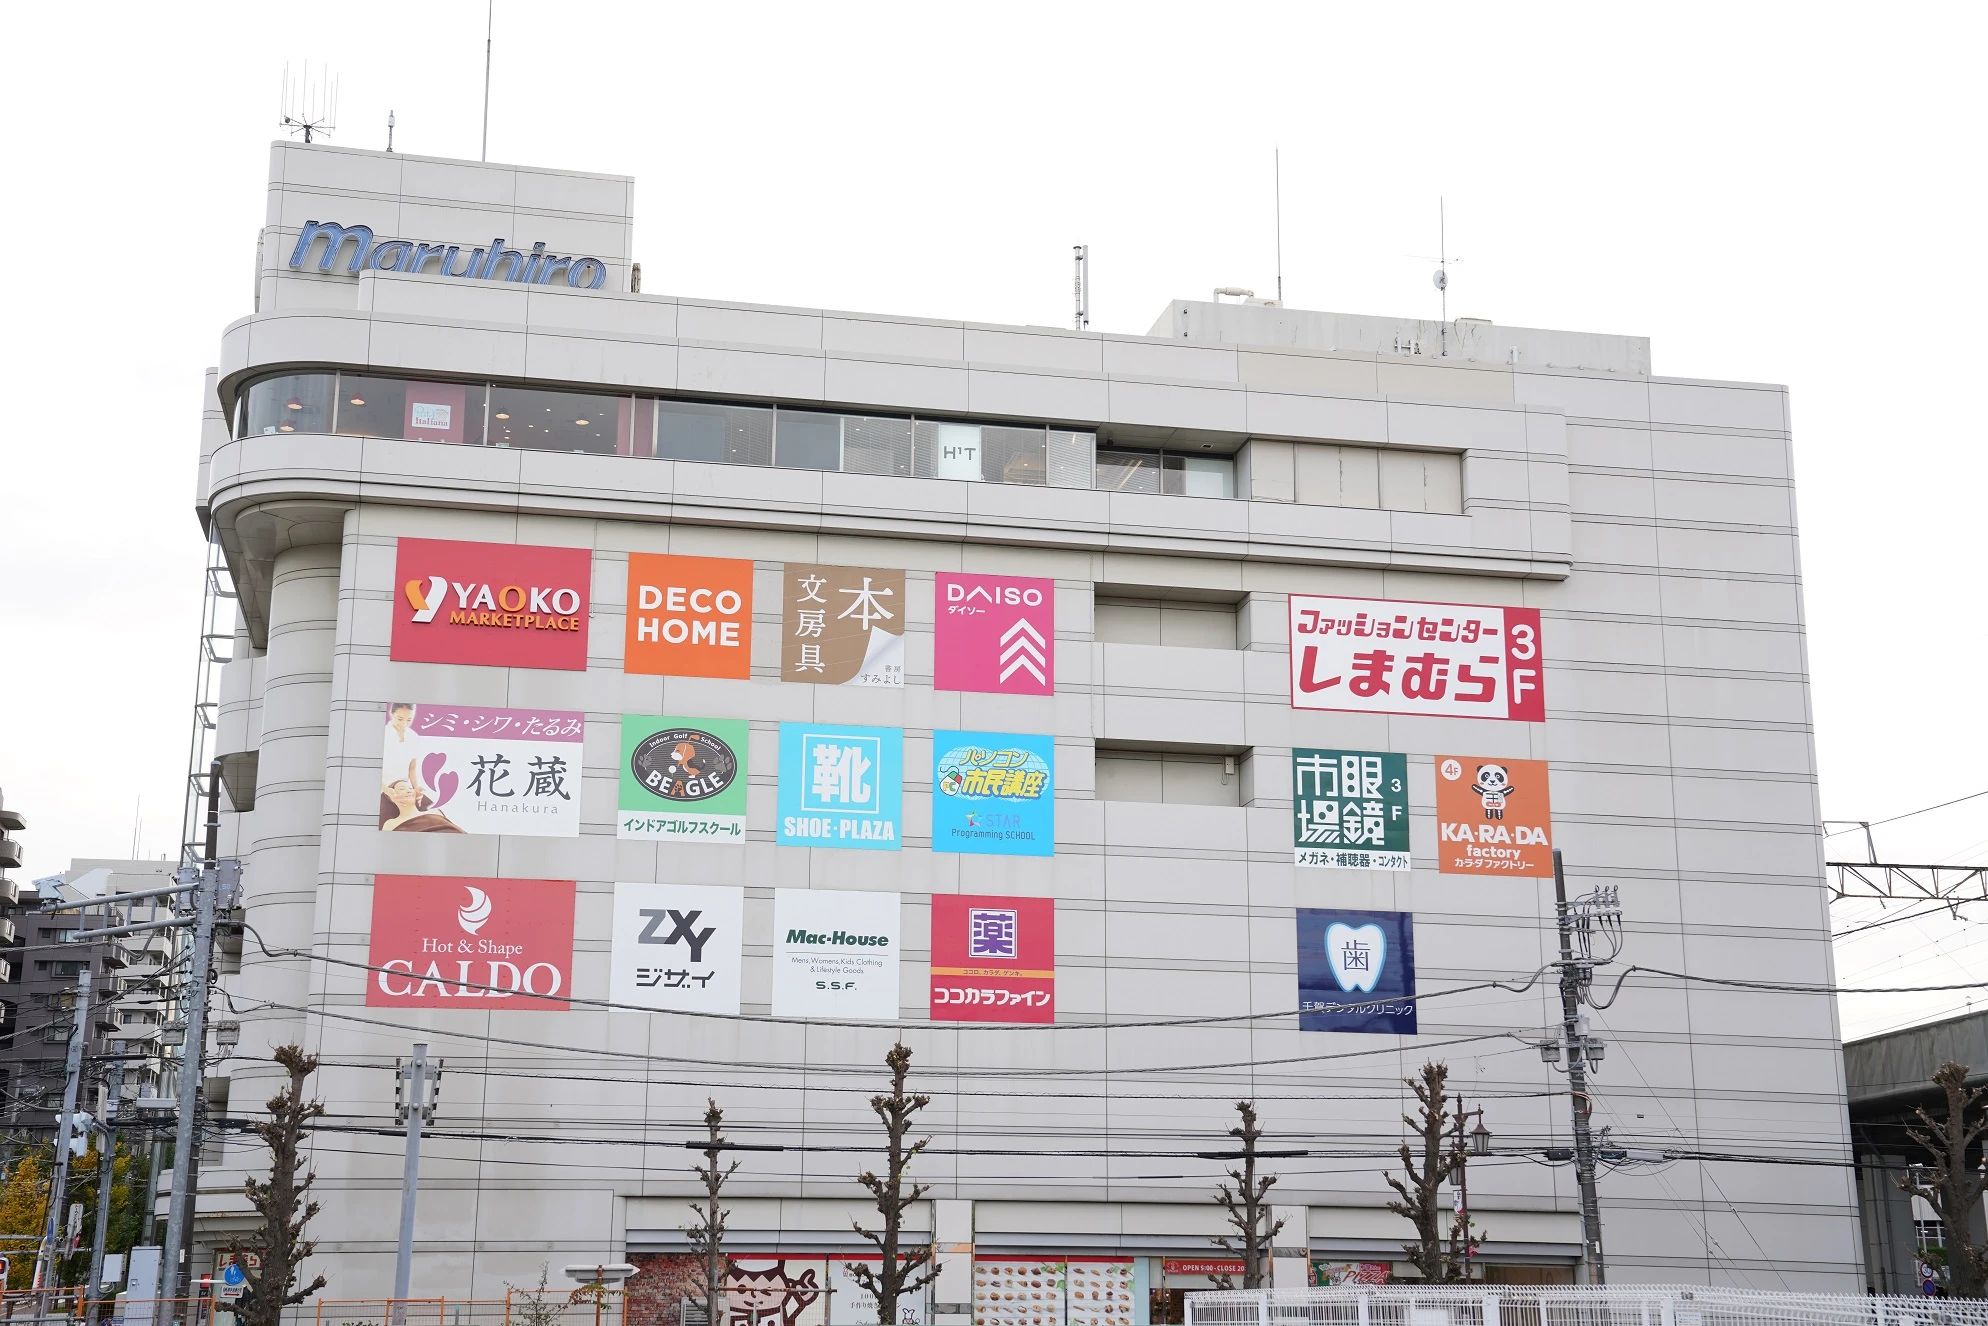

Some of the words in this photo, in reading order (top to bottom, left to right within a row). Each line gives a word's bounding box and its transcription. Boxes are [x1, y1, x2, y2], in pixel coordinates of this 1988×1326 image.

[288, 220, 608, 289] maruhiro
[451, 582, 581, 616] YAOKO
[638, 584, 742, 615] DECO
[837, 577, 895, 631] 本
[946, 583, 1043, 607] DAISO
[449, 610, 580, 632] MARKETPLACE
[947, 605, 986, 616] ダイソー
[637, 617, 741, 647] HOME
[795, 574, 828, 673] 文房具
[1297, 609, 1499, 644] ファッションセンター
[860, 673, 901, 685] すみよし
[1299, 645, 1500, 703] しまむら
[648, 735, 671, 748] Indoor
[700, 736, 722, 751] School
[959, 748, 1030, 768] パソコン
[466, 752, 571, 801] 花蔵
[811, 743, 872, 804] 靴
[1444, 763, 1459, 776] 4F
[645, 769, 724, 797] BEAGLE
[961, 767, 1047, 799] 市民講座
[477, 800, 558, 815] Hanakura
[623, 818, 741, 836] インドアゴルフスクール
[986, 813, 1021, 828] STAR
[951, 828, 1003, 841] Programming
[1005, 830, 1036, 841] SCHOOL
[1466, 844, 1521, 860] factory
[638, 908, 717, 962] ZXY
[785, 929, 889, 946] Mac-House
[973, 913, 1013, 954] 薬
[422, 937, 453, 953] Hot
[458, 939, 474, 954] &
[478, 938, 523, 959] Shape
[1341, 940, 1371, 972] 歯
[816, 966, 841, 974] Lifestyle
[842, 966, 865, 974] Goods
[856, 958, 883, 968] Clothing
[378, 958, 562, 998] CALDO
[815, 981, 857, 990] S.S.F.
[934, 987, 1051, 1006] ココカラファイン
[1341, 1269, 1390, 1284] PIZZA
